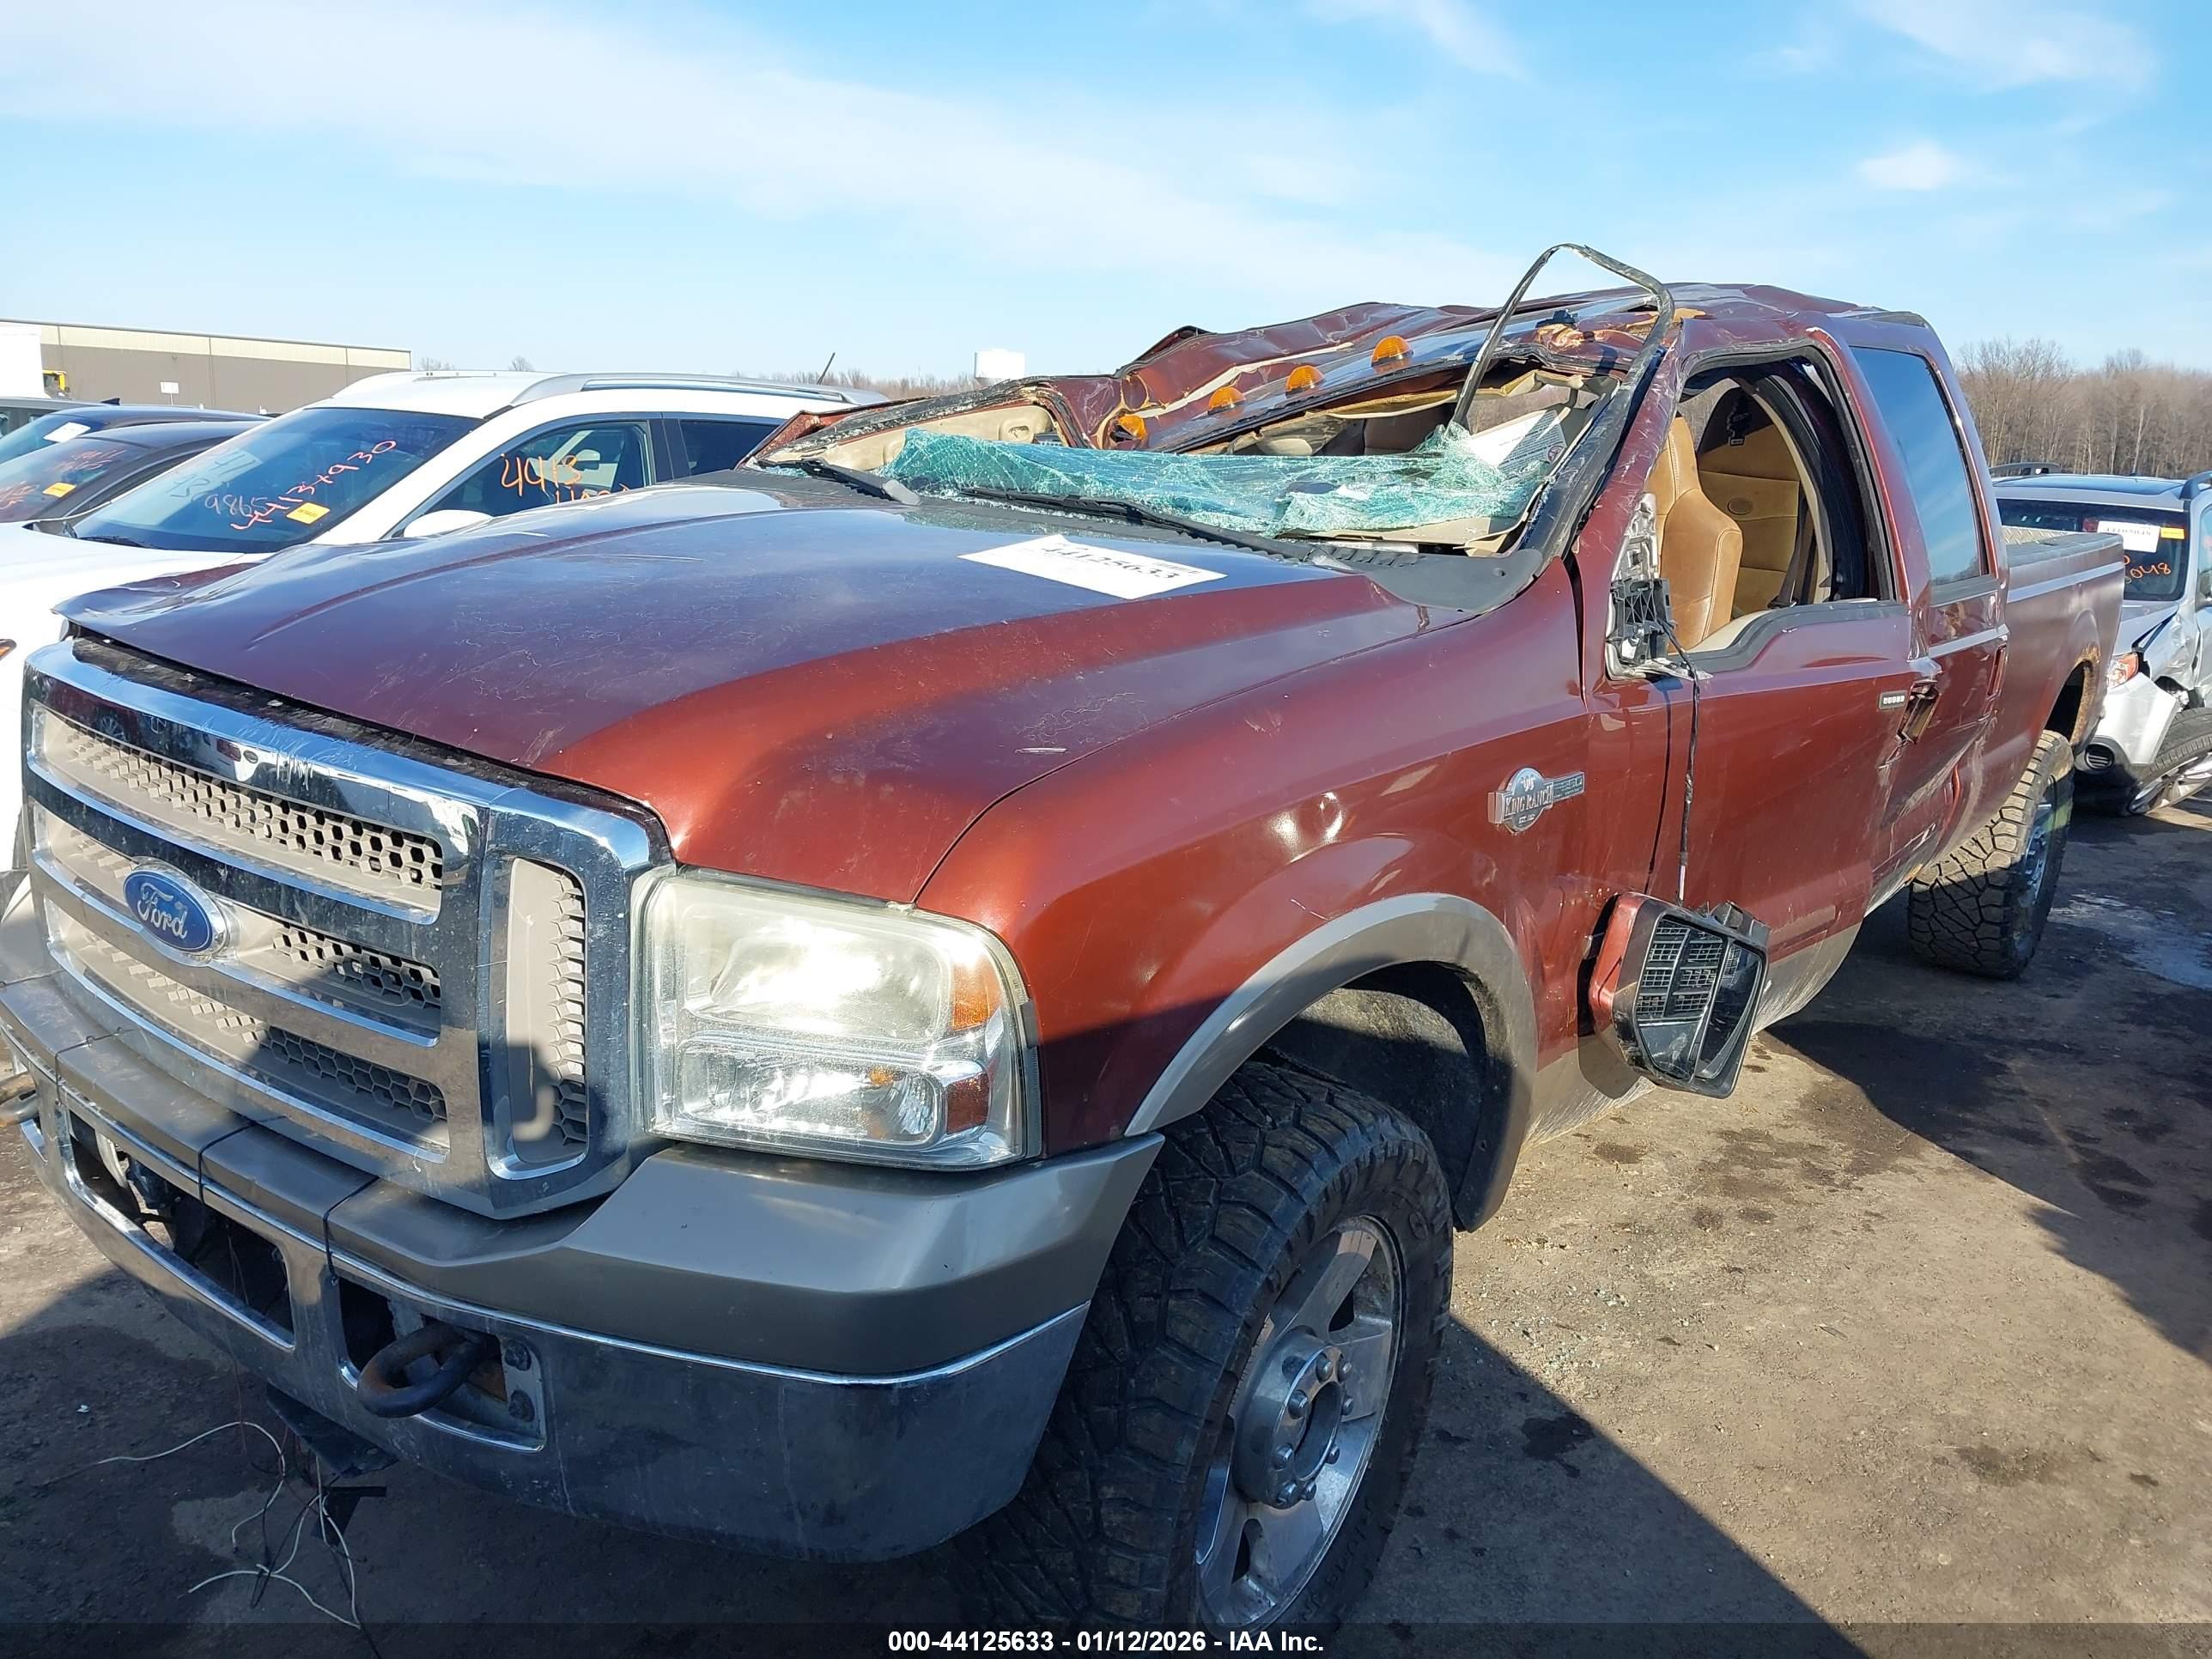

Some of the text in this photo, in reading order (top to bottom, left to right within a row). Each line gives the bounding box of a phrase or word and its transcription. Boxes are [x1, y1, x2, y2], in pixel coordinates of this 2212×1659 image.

[1041, 547, 1181, 580] 44125633
[1504, 795, 1525, 816] KING
[1526, 784, 1553, 810] RANCH
[137, 882, 188, 939] Ford
